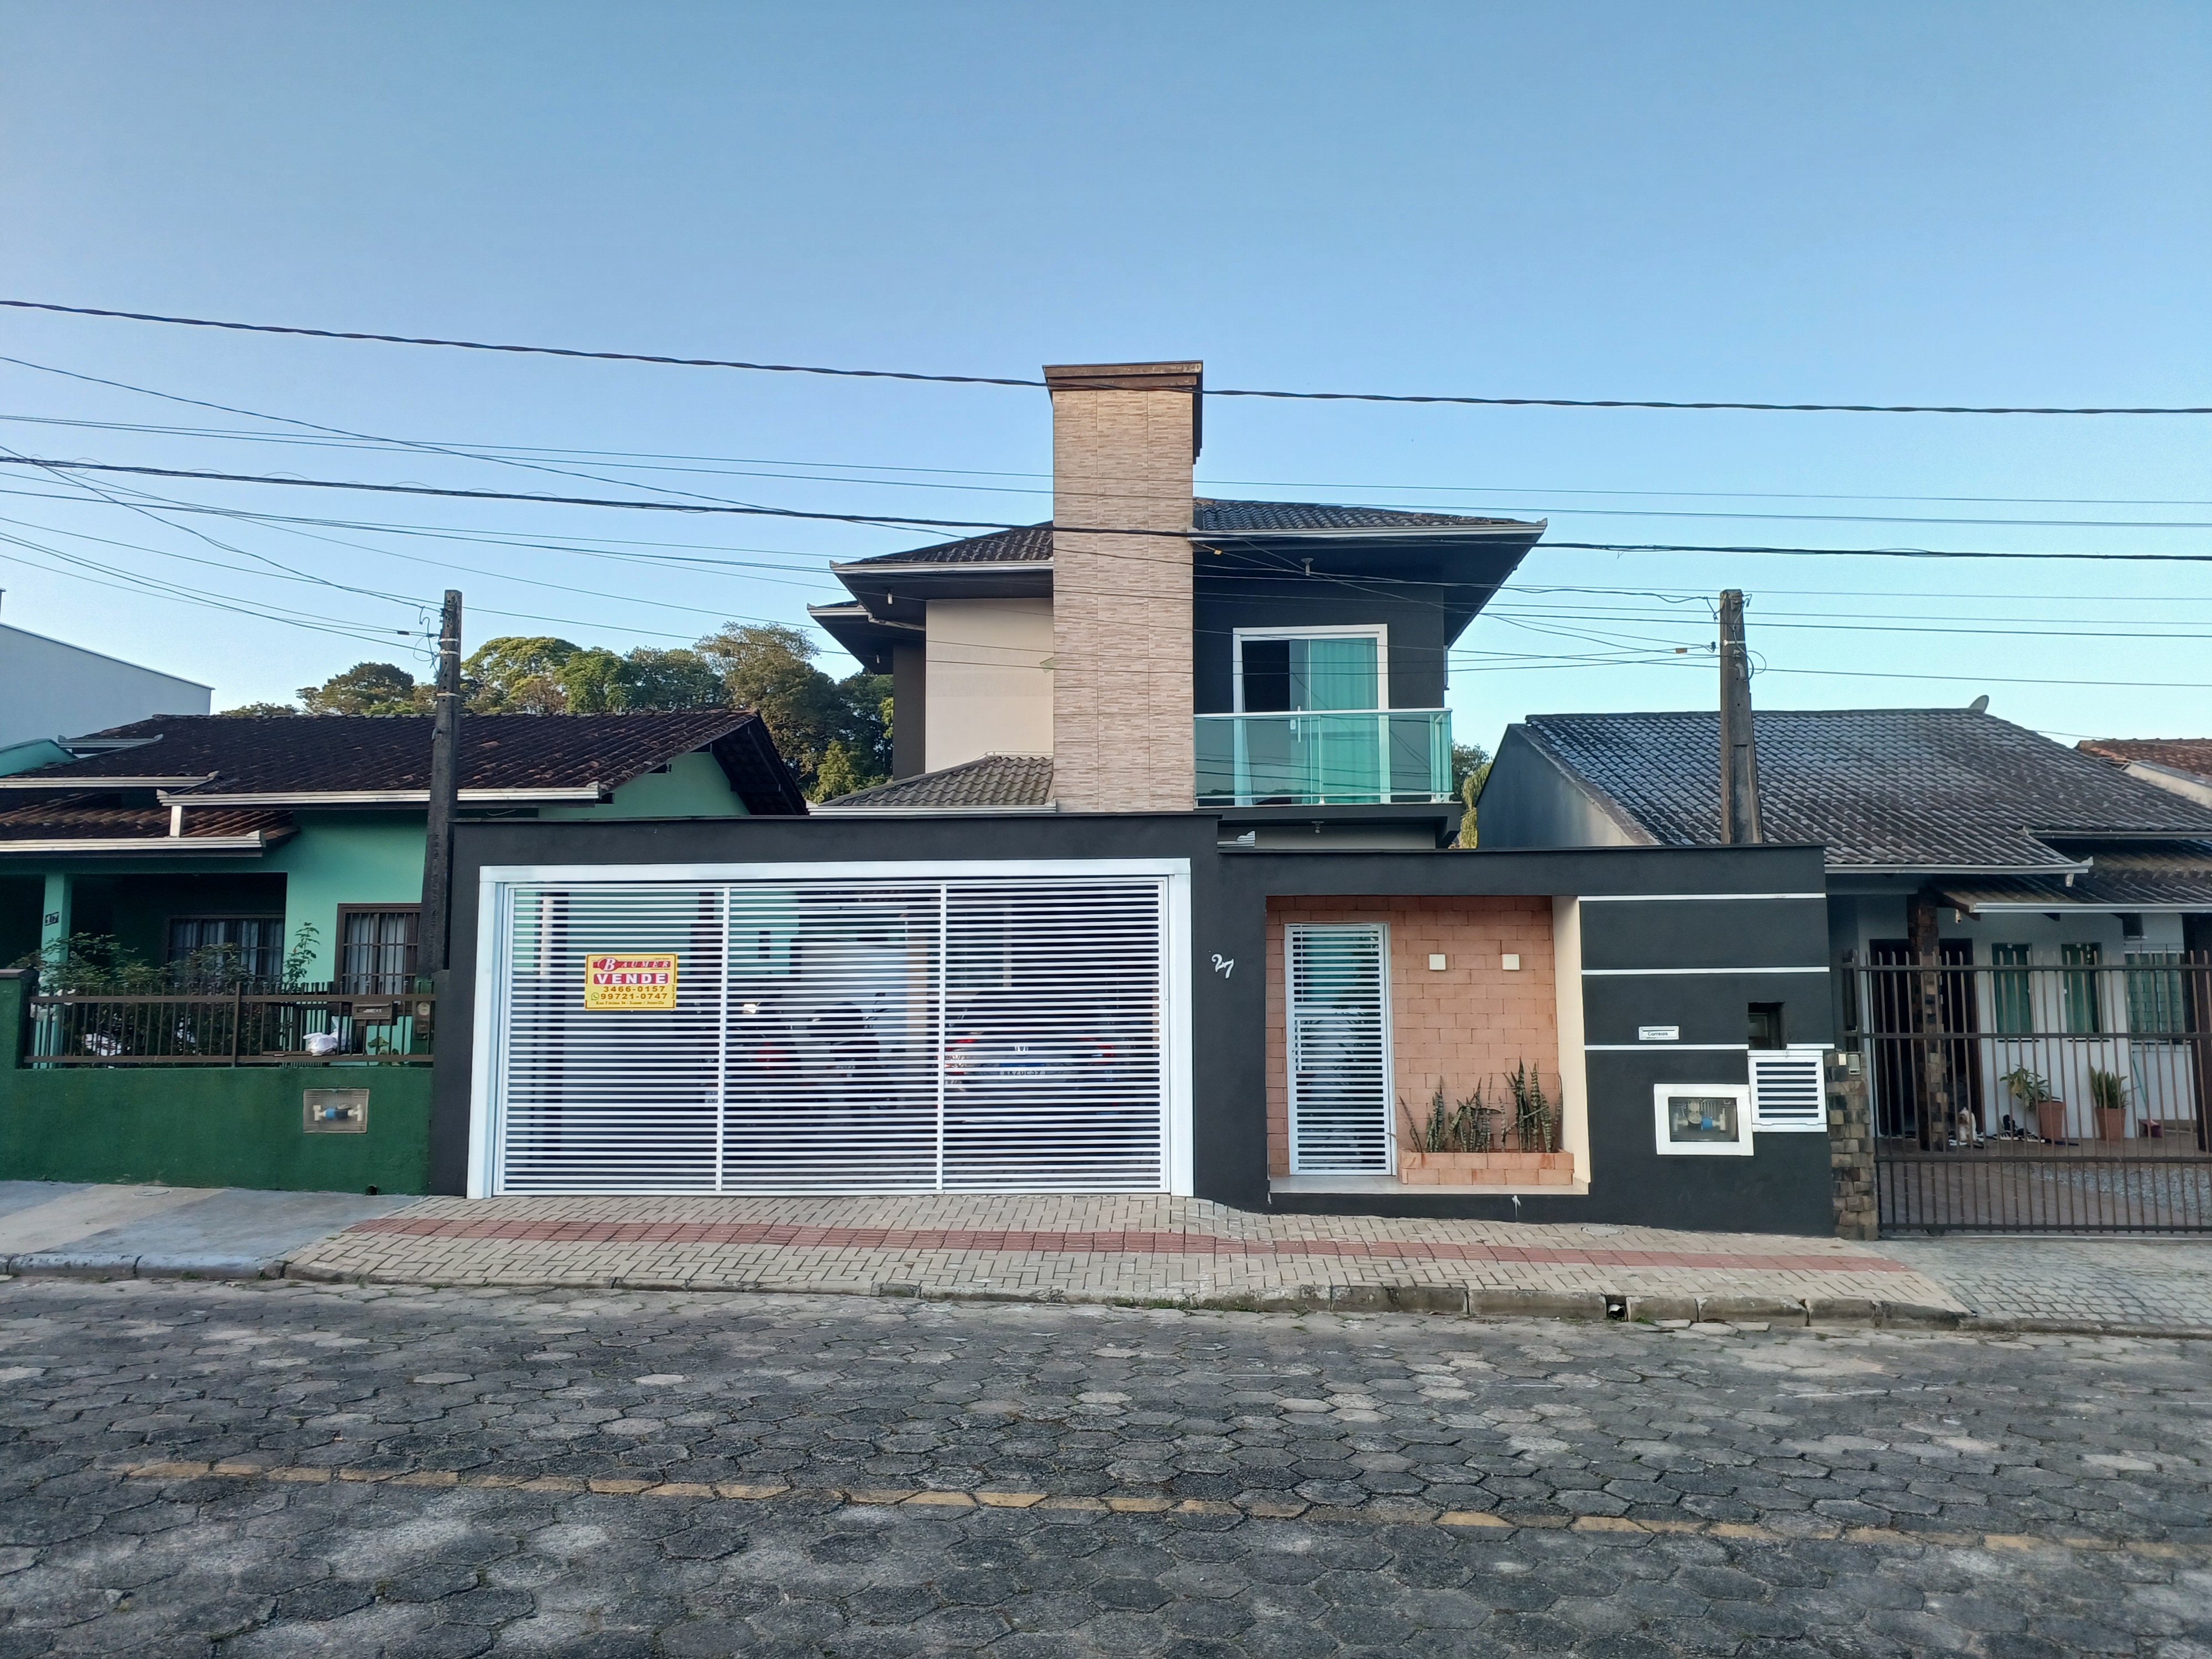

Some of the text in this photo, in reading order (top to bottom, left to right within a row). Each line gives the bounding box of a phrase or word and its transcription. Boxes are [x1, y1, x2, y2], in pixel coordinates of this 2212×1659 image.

[603, 958, 669, 971] BAUMER
[1211, 953, 1234, 979] 27
[596, 973, 666, 984] VENDE
